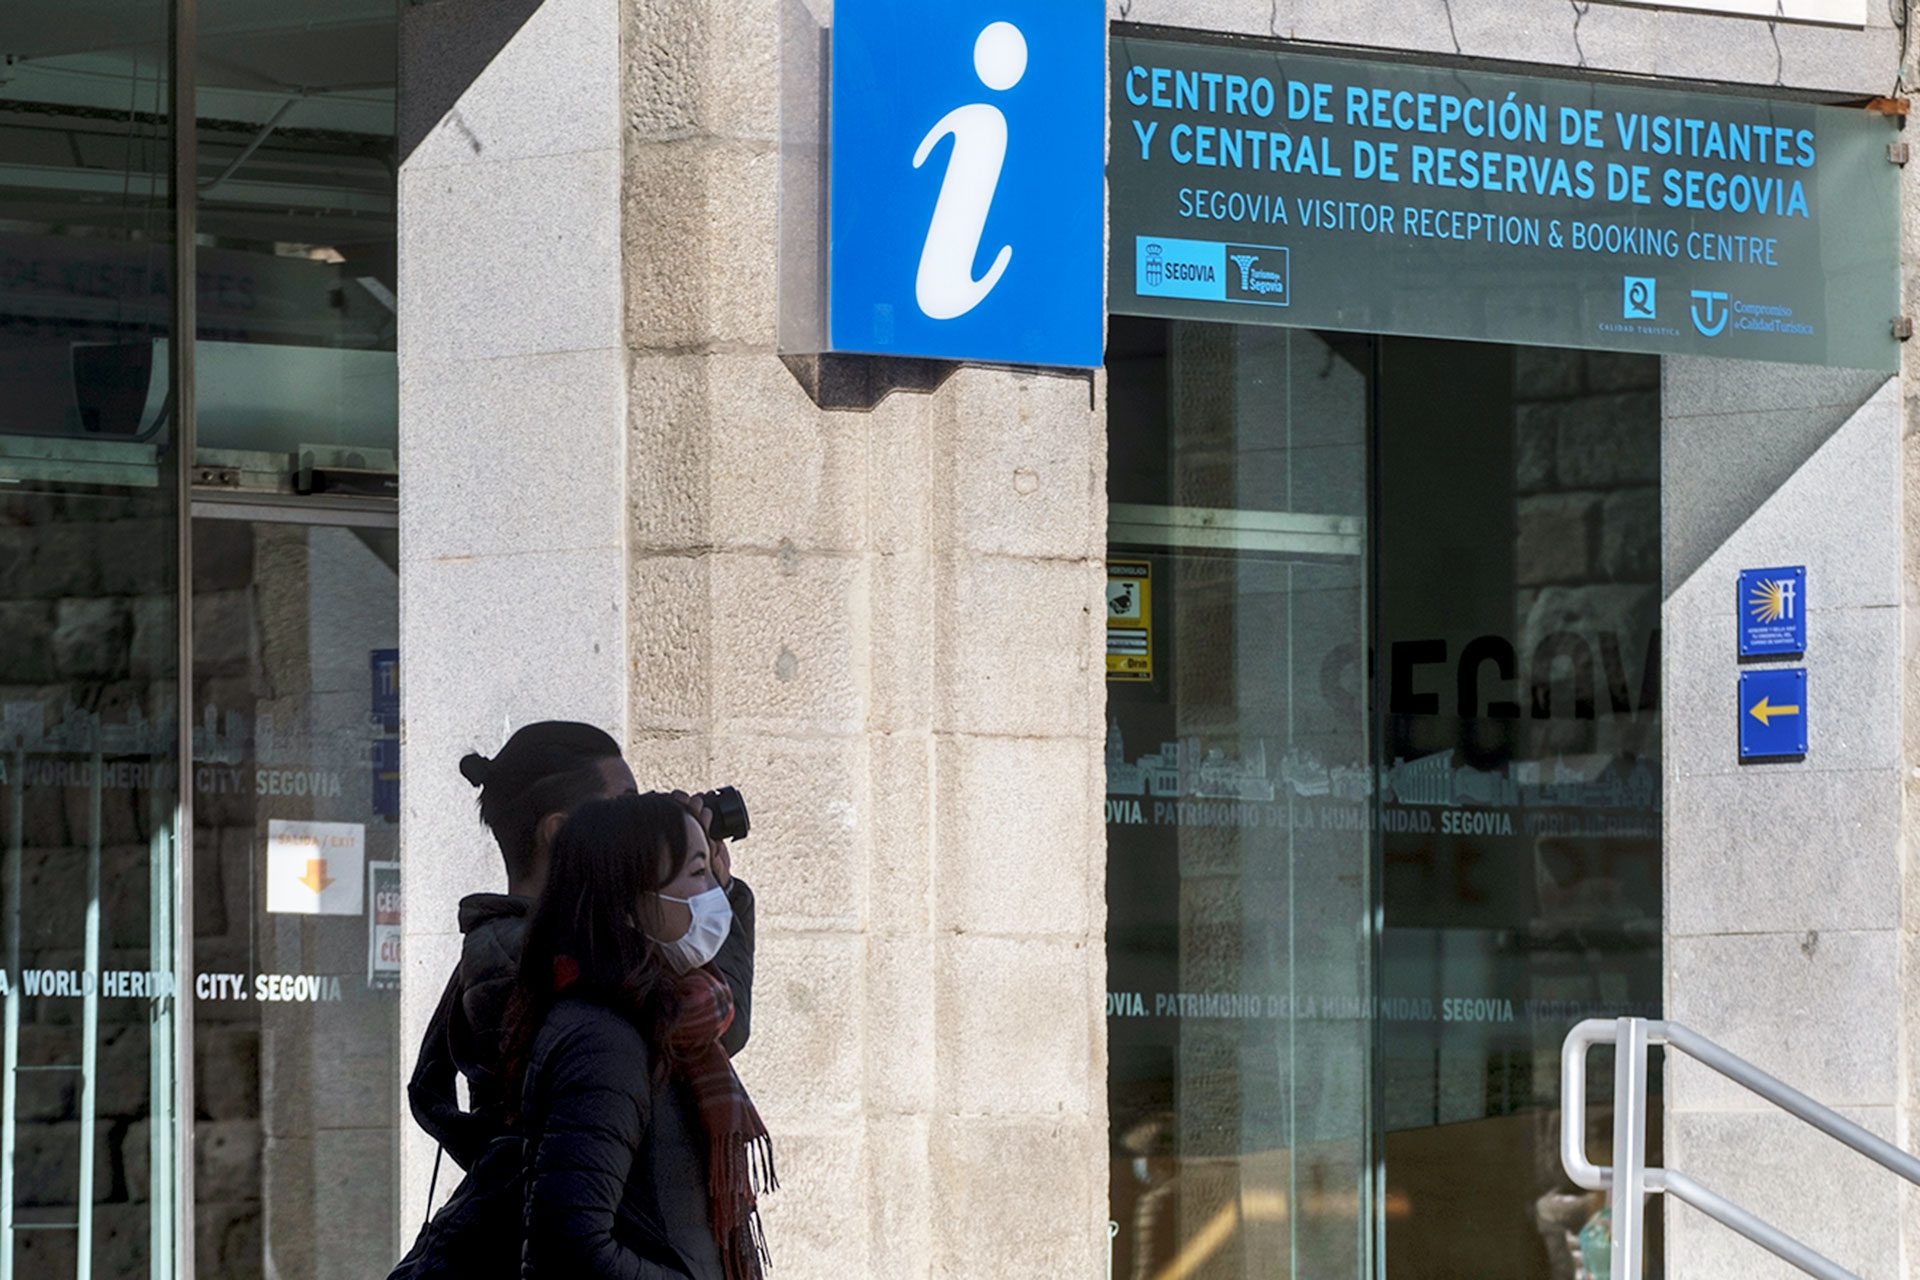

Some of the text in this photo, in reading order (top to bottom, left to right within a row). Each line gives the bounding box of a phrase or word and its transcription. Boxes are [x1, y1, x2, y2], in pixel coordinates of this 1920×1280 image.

[1126, 66, 1815, 168] CENTRO DE RECEPCIÓN DE VISITANTES
[1133, 120, 1810, 218] Y CENTRAL DE RESERVAS DE SEGOVIA
[1179, 188, 1778, 266] SEGOVIA VISITOR RECEPTION & BOOKING CENTRE
[1165, 262, 1215, 283] SEGOVIA
[1249, 277, 1284, 294] Segovia
[1733, 300, 1793, 317] Compromiso
[1598, 323, 1634, 333] CALIDAD
[256, 770, 342, 797] SEGOVIA
[1106, 799, 1148, 825] OVIA.
[1154, 802, 1259, 829] PATRIMONIO
[277, 834, 320, 848] SALIDA
[330, 836, 356, 848] EXIT
[22, 969, 96, 997] WORLD
[196, 973, 342, 1002] CITY. SEGOVIA
[1106, 992, 1150, 1017] OVIA.
[1155, 993, 1261, 1019] PATRIMONIO
